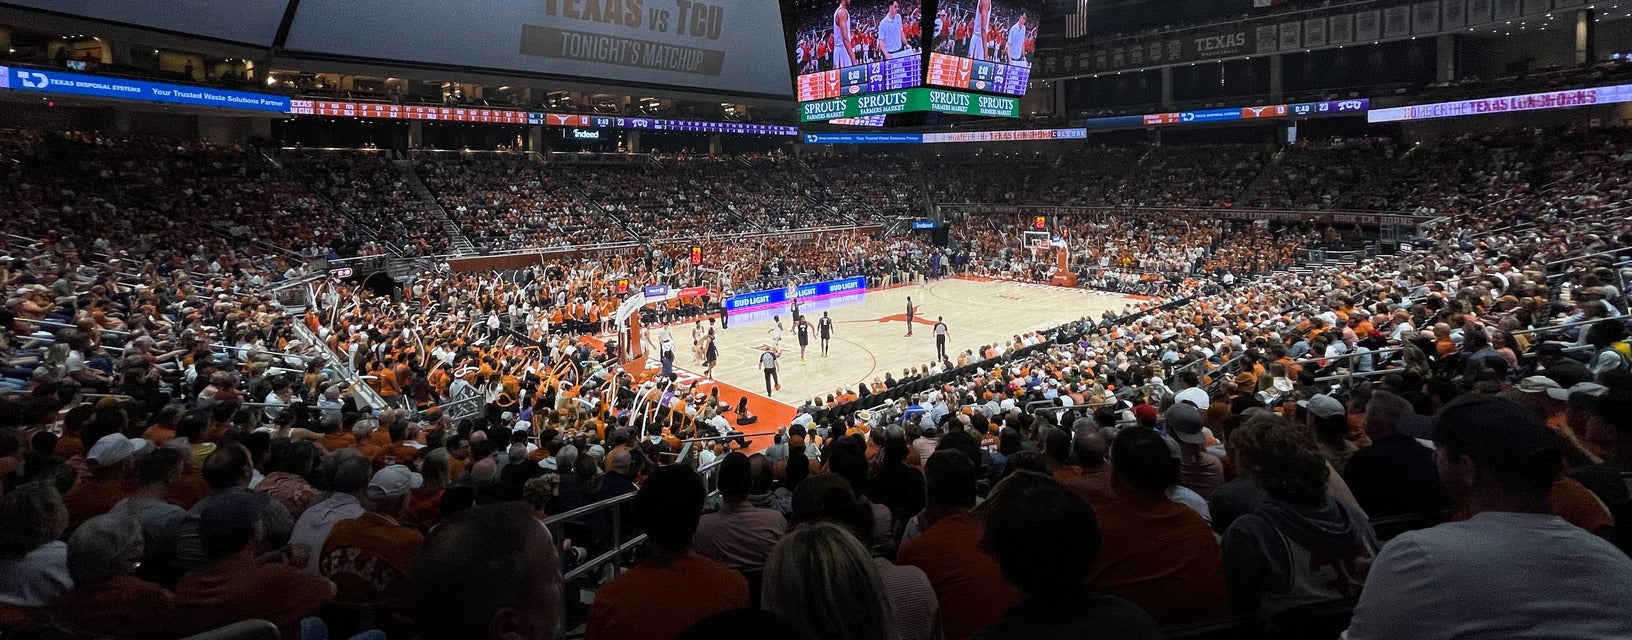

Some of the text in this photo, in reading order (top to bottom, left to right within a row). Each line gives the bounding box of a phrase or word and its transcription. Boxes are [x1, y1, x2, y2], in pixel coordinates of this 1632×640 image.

[677, 0, 724, 40] TCU
[1195, 32, 1246, 51] TEXAS
[561, 32, 704, 71] TONIGHT'S MATCHUP
[871, 63, 880, 74] 23
[76, 81, 111, 90] DISPOSAL
[112, 85, 141, 93] SYSTEMS
[152, 88, 283, 107] Your Trusted Waste Solutions Partner
[858, 92, 907, 109] SPROUTS
[929, 90, 970, 106] SPROUTS
[978, 96, 1014, 110] SPROUTS
[804, 99, 847, 115] SPROUTS
[860, 104, 905, 115] FARMERS MARKET
[932, 103, 951, 111] FARMERS
[1319, 102, 1329, 111] 23
[1338, 101, 1362, 110] TCU
[1469, 98, 1509, 114] TEXAS
[806, 112, 826, 120] FARMERS
[826, 110, 845, 118] MARKET
[617, 118, 625, 126] 23
[632, 119, 648, 127] TCU
[573, 129, 600, 139] indeed
[990, 131, 1012, 140] TEXAS
[597, 247, 635, 258] WELCOME
[830, 281, 858, 292] BUD LIGHT
[799, 288, 816, 297] LIGHT
[734, 295, 769, 307] BUD LIGHT
[321, 547, 395, 592] TEXAS
